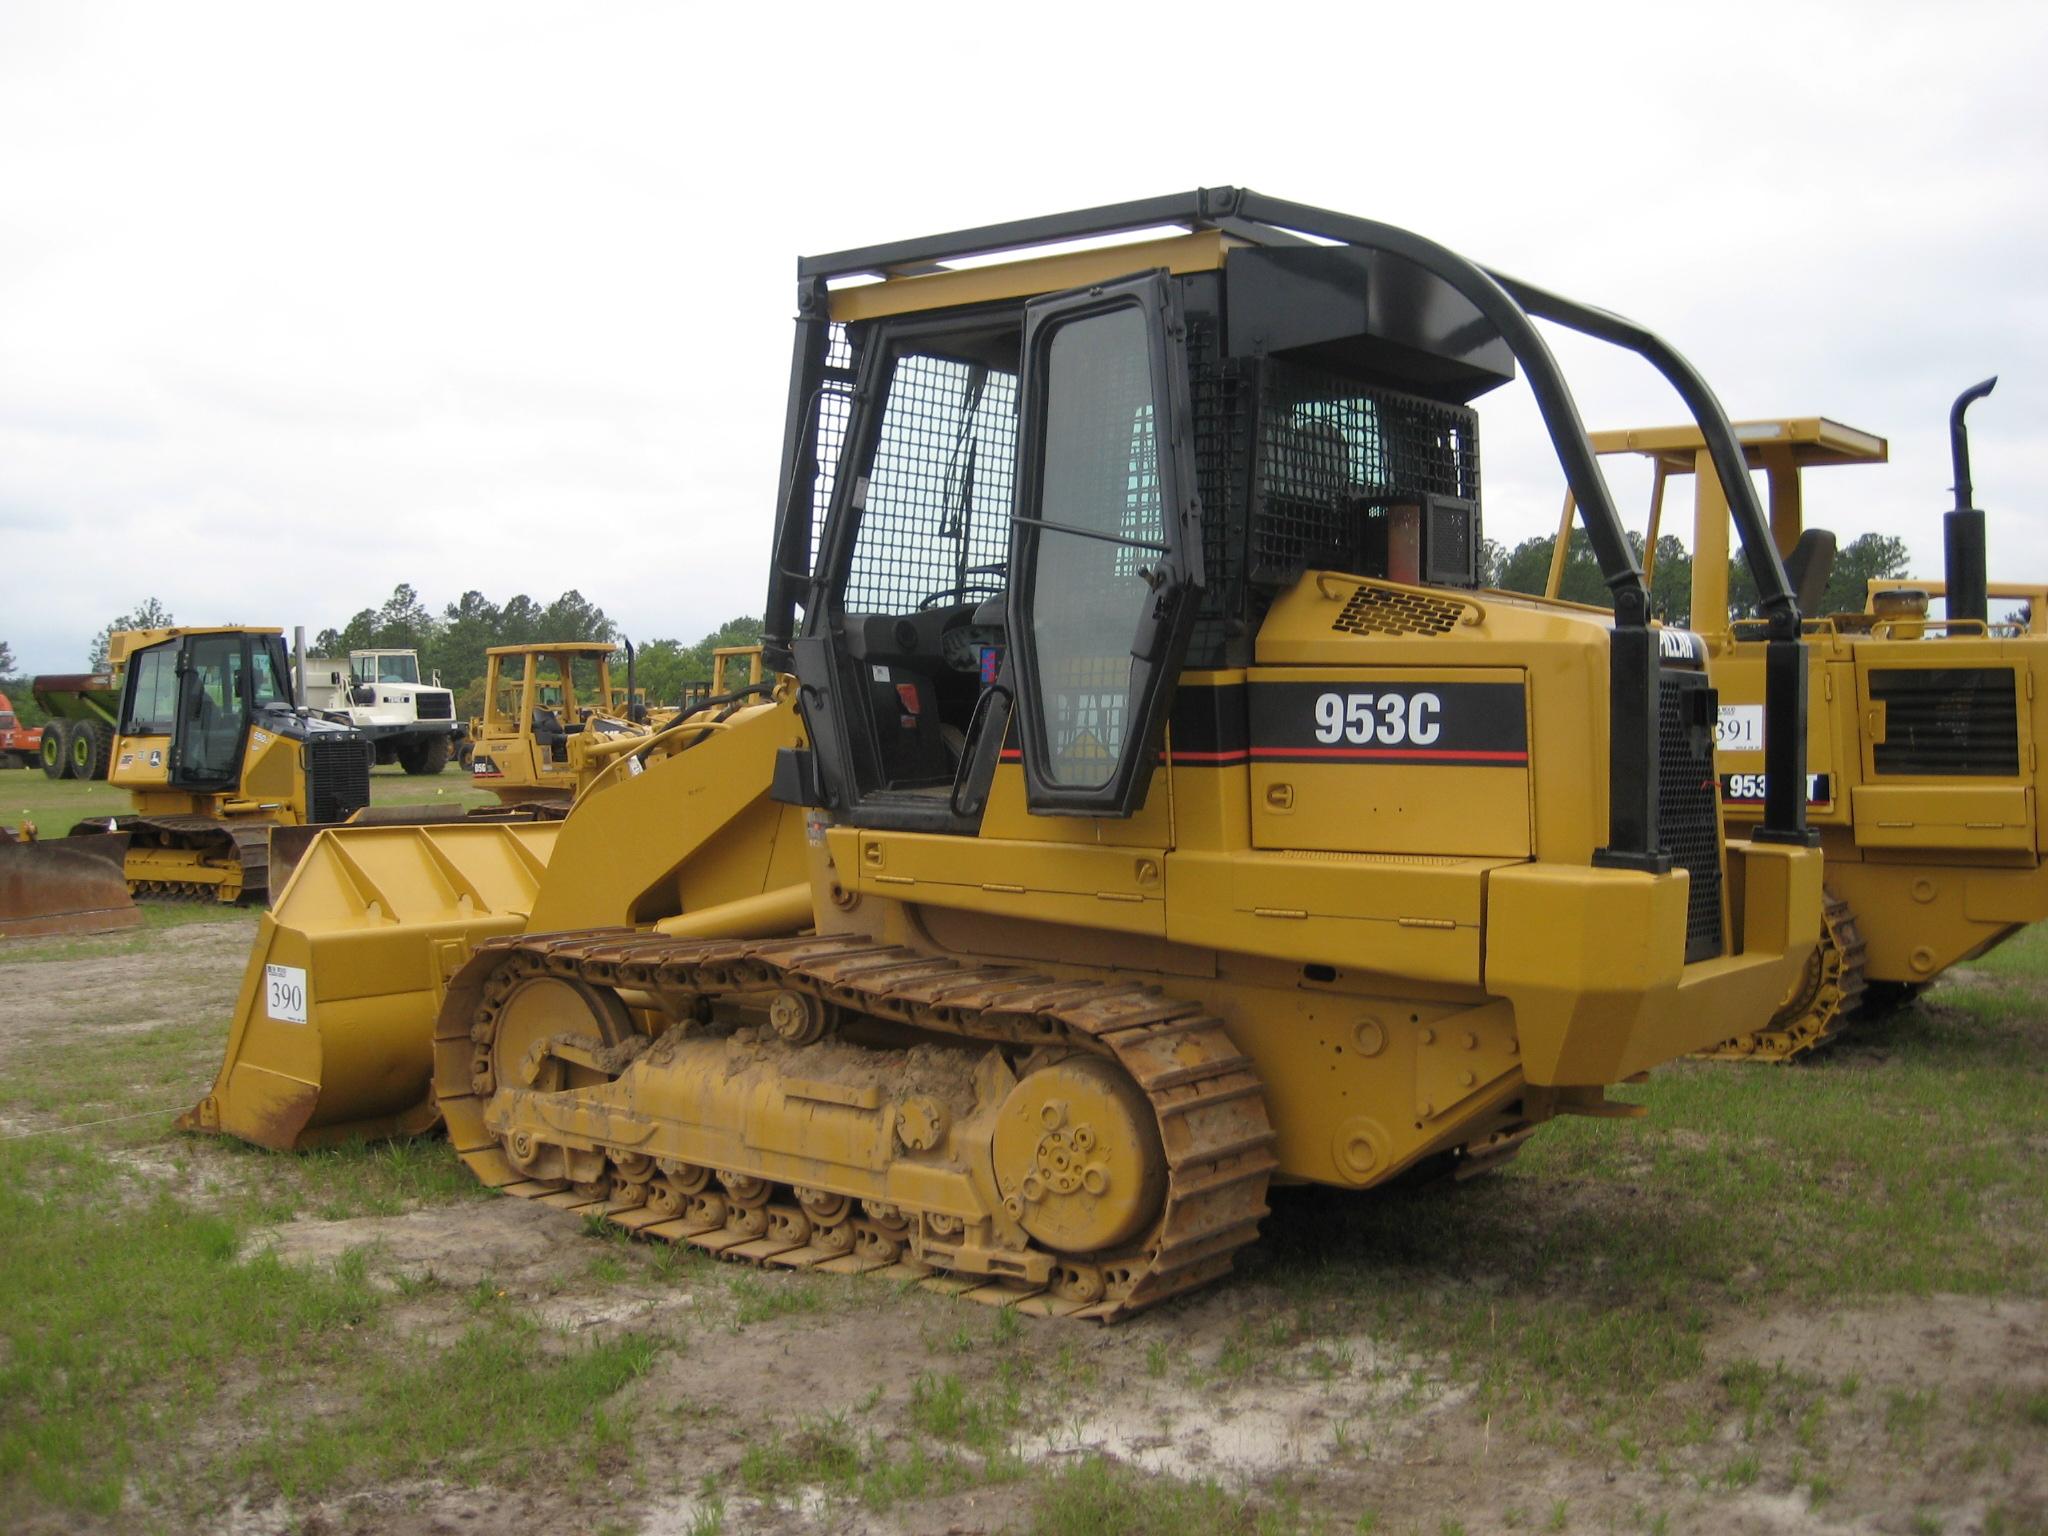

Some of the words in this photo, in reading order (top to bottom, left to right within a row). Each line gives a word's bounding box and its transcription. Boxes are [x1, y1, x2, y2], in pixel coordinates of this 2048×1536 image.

[1315, 692, 1441, 745] 953C
[1717, 719, 1752, 741] 391
[271, 981, 302, 1012] 390
